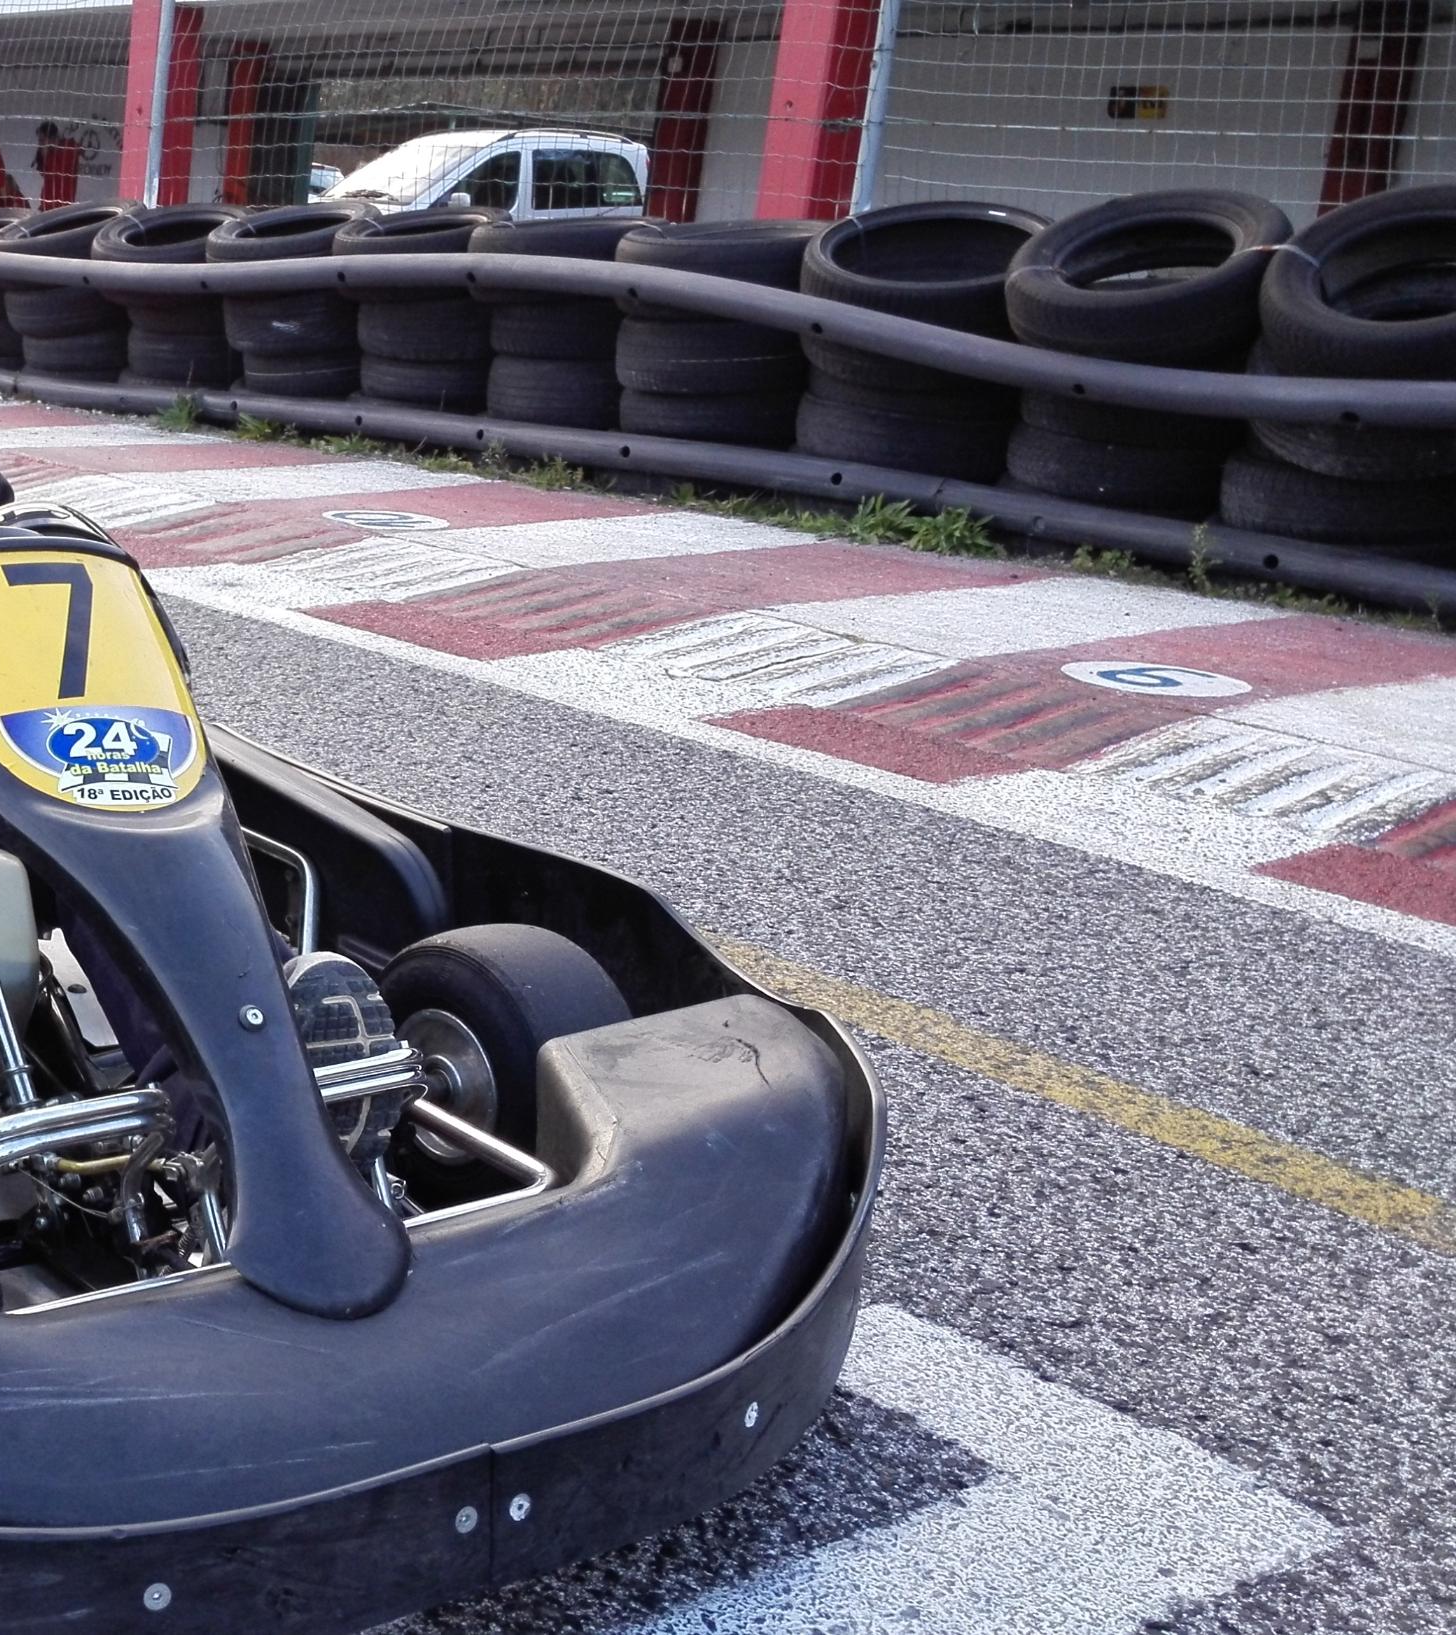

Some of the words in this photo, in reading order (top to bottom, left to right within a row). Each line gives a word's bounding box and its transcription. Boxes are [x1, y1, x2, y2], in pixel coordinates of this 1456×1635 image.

[0, 562, 94, 700] 7
[63, 721, 138, 758] 24
[85, 749, 131, 761] horas
[70, 763, 93, 776] da
[95, 761, 163, 775] Batalha
[109, 786, 173, 803] EDIÇÃO
